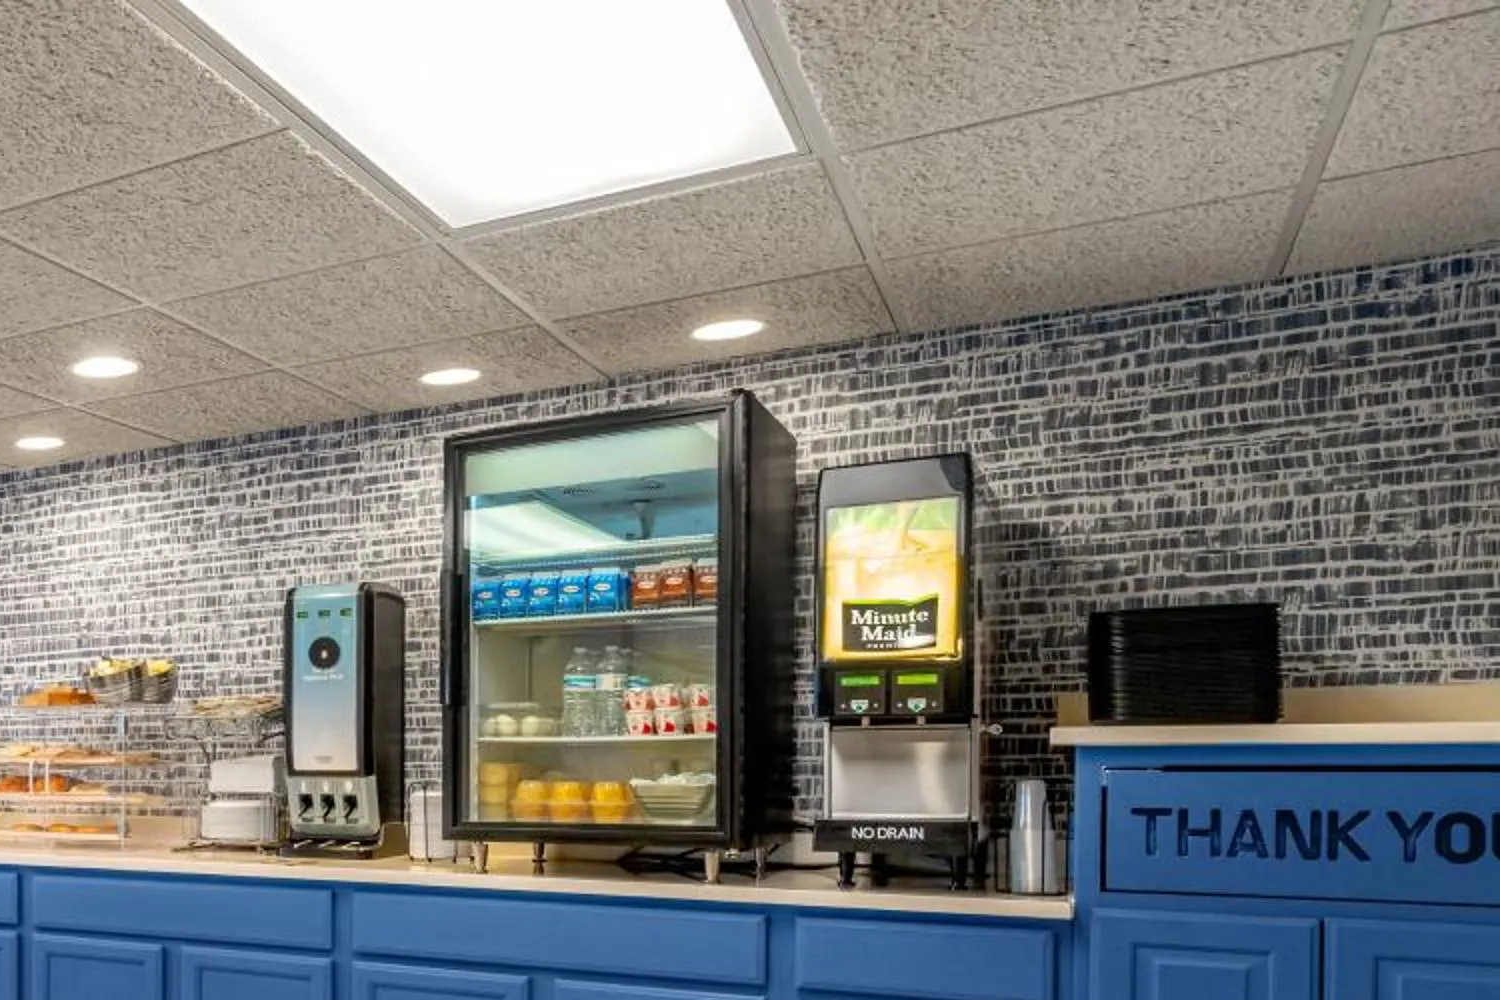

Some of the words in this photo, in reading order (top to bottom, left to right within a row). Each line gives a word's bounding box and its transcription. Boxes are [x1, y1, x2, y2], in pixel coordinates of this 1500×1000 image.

[851, 608, 929, 625] Minute
[861, 624, 917, 641] Maid
[851, 827, 874, 839] NO
[876, 827, 924, 840] DRAIN
[1131, 807, 1372, 863] THANK
